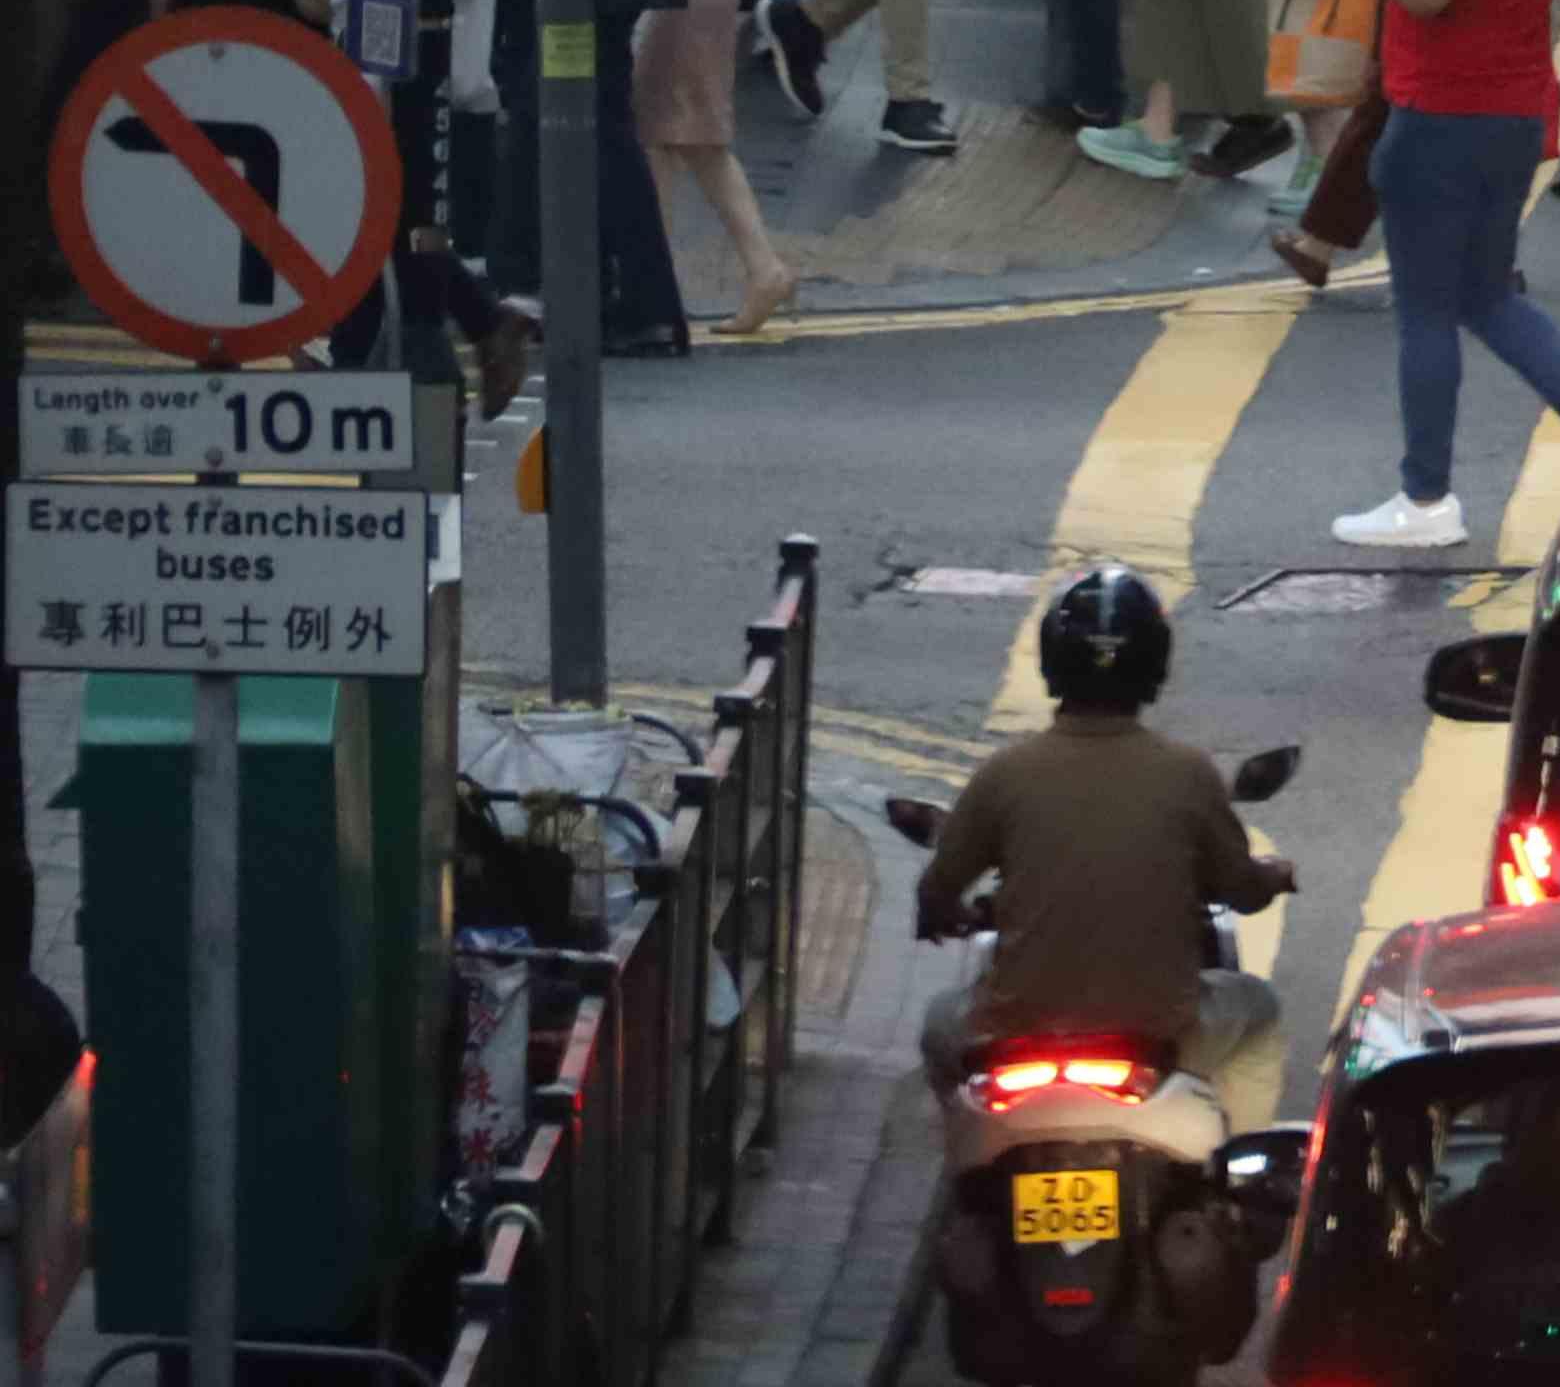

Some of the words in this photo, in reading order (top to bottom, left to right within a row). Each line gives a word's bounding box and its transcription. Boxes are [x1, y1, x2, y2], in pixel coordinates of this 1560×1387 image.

[33, 387, 130, 415] Length
[140, 393, 200, 410] over
[224, 390, 314, 455] 10
[330, 404, 395, 452] m
[28, 498, 171, 540] Except
[185, 500, 406, 540] franchised
[156, 546, 276, 581] buses
[38, 600, 392, 652] 專利巴士例外
[1022, 1205, 1113, 1236] 5065
